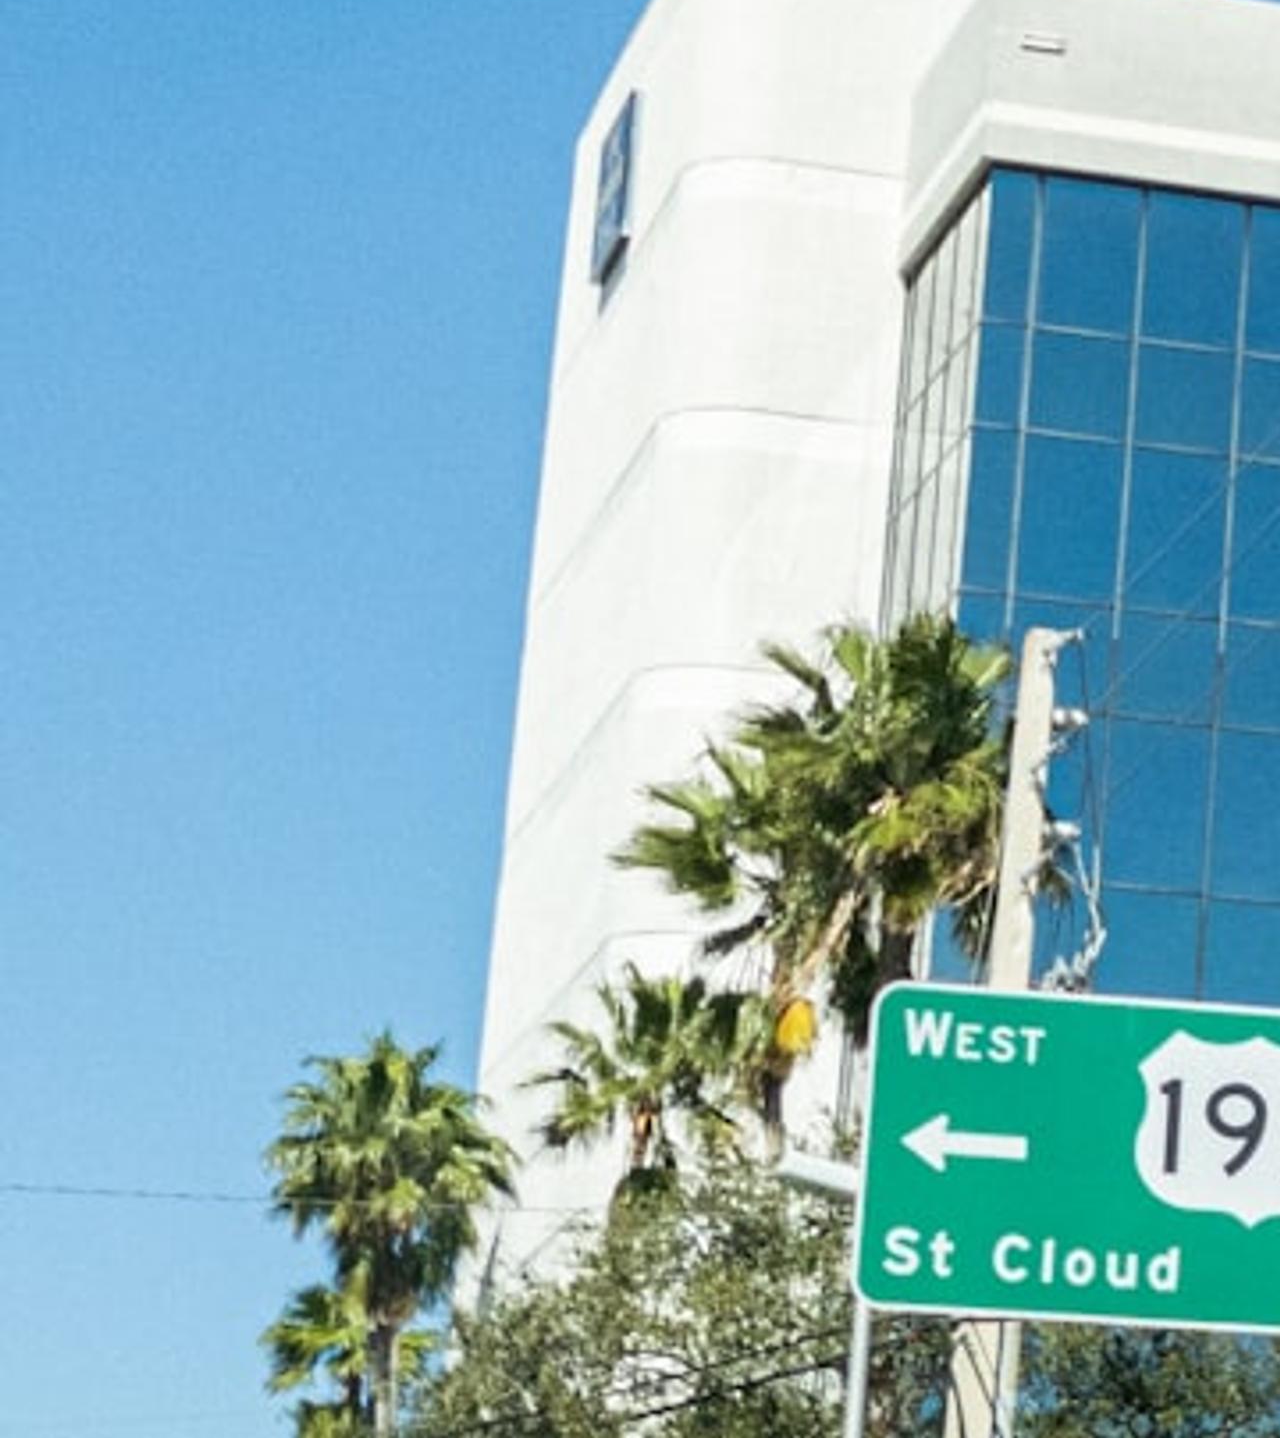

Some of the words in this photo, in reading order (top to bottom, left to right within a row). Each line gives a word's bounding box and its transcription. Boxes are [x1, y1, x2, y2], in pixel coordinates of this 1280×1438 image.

[905, 1009, 1046, 1064] WEST
[883, 1227, 955, 1278] St
[992, 1234, 1180, 1291] Cloud
